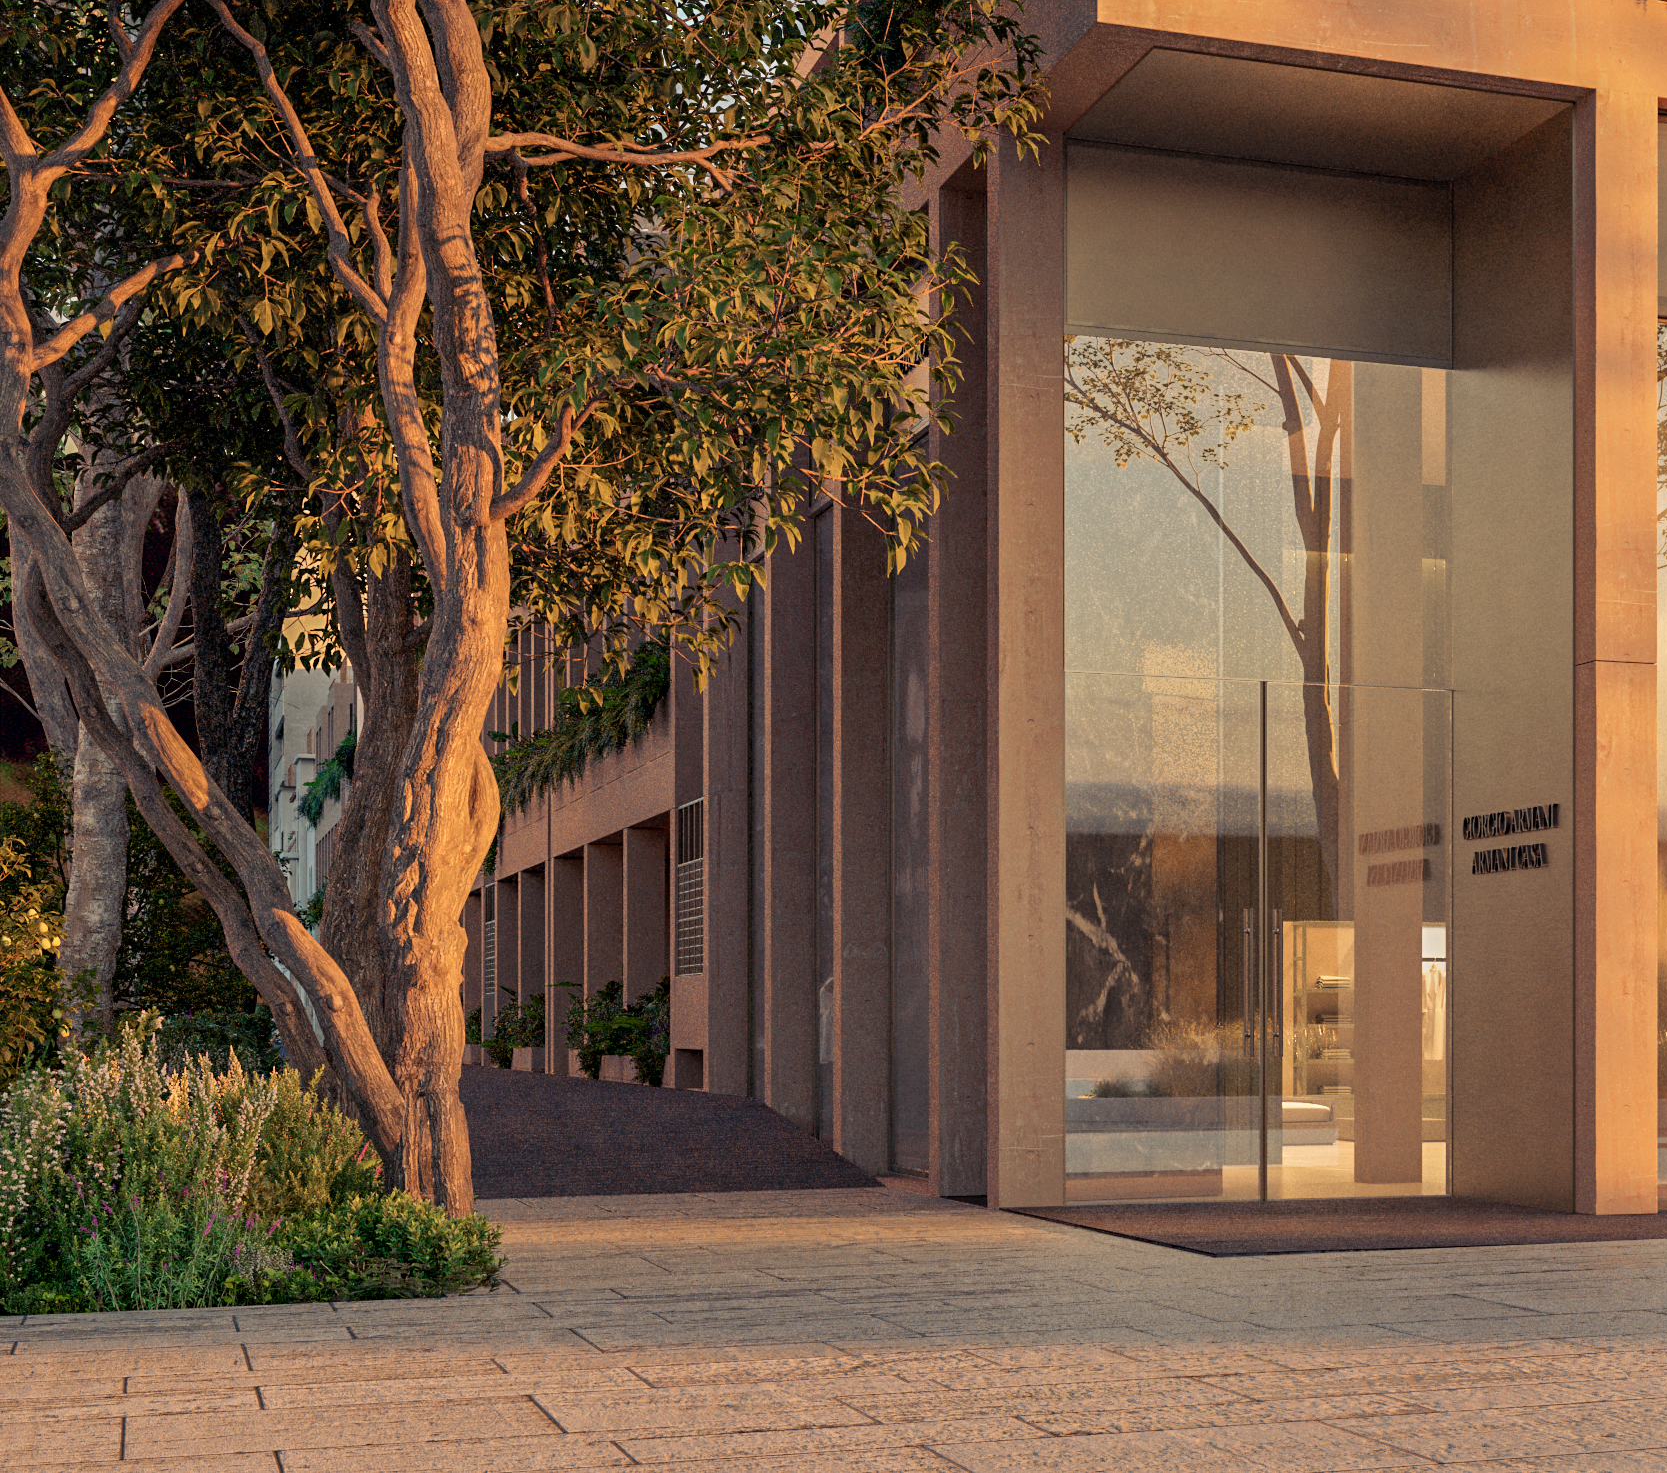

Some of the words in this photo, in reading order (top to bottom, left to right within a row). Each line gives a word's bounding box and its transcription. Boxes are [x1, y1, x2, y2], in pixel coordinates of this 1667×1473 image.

[1462, 811, 1512, 841] GIORGIO
[1511, 803, 1560, 835] ARMANI
[1472, 847, 1518, 875] ARMANI
[1517, 842, 1549, 870] CASA
